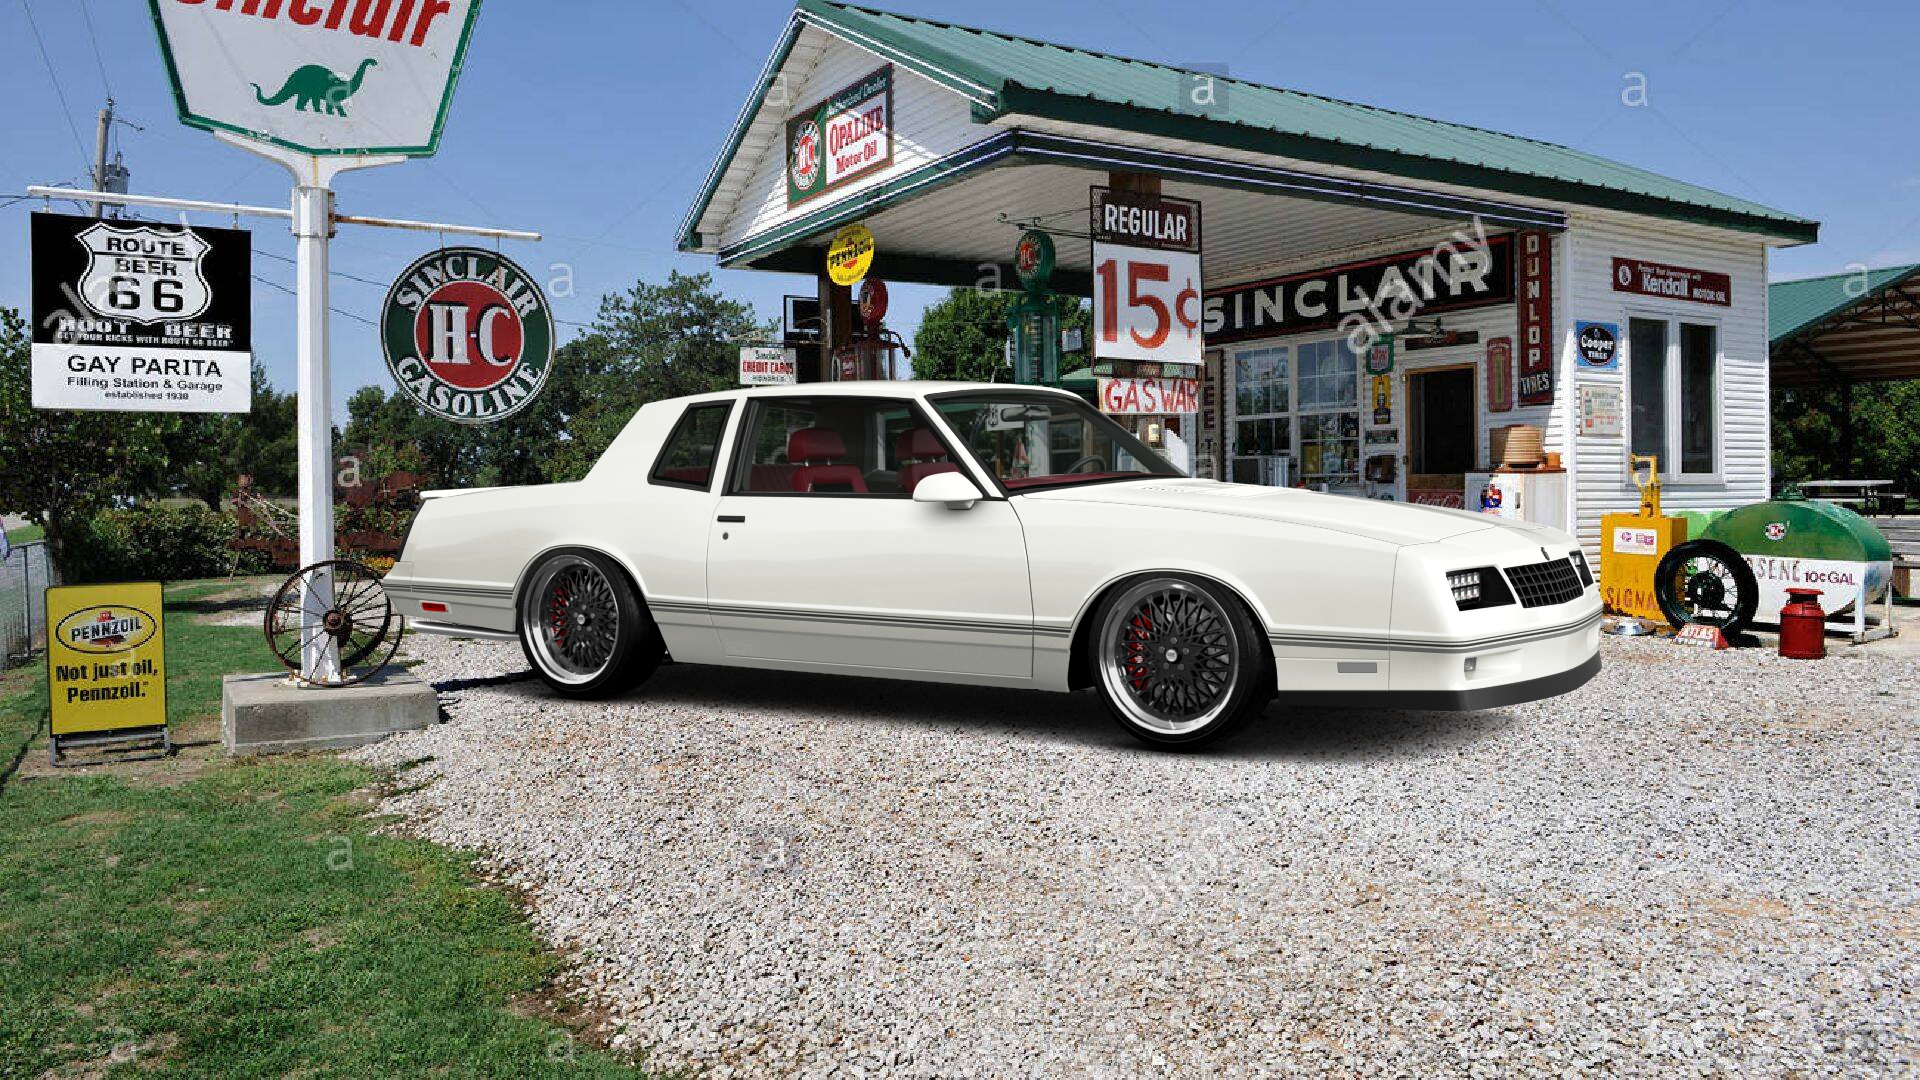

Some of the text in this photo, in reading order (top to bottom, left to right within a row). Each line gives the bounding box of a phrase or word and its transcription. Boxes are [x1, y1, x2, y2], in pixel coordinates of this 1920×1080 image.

[176, 0, 449, 47] clair
[829, 105, 884, 156] OPALINE
[1104, 203, 1187, 241] REGULAR
[107, 237, 186, 256] ROUTE
[115, 257, 177, 276] BEER
[108, 275, 185, 312] 66
[396, 256, 540, 318] SINCLAIR
[1203, 247, 1489, 334] SINCLAIR
[1642, 271, 1688, 296] Kendall
[1096, 259, 1199, 349] 15¢
[1526, 235, 1541, 368] DUNLOP
[164, 321, 232, 339] BEER
[1581, 334, 1614, 351] Cooper
[67, 354, 222, 378] GAY PARITA
[67, 377, 223, 394] Filling Station & Garage
[104, 391, 163, 400] established
[397, 356, 542, 417] GASOLINE
[1104, 378, 1199, 413] GAS WAR
[1521, 373, 1549, 396] TIRES
[1827, 570, 1856, 586] GAL
[71, 616, 142, 642] PENNZOIL
[56, 659, 158, 682] Not just oil,
